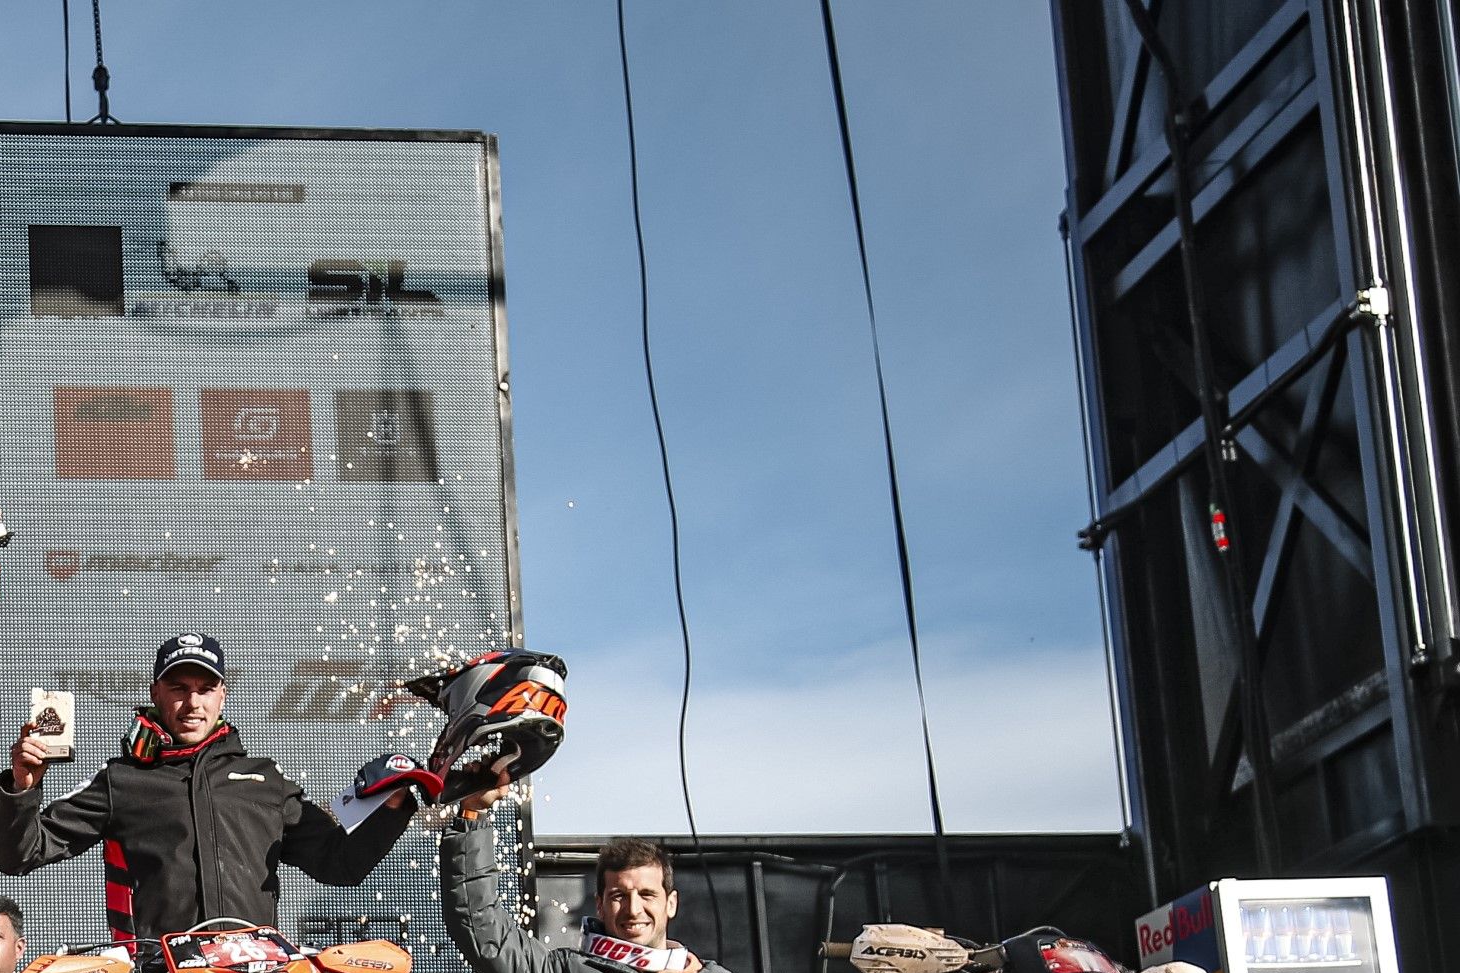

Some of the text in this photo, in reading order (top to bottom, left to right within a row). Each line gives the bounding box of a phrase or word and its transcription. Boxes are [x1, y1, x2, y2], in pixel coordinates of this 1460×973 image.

[1139, 895, 1214, 958] Red Bull
[221, 941, 268, 963] 26
[860, 946, 927, 961] ACERBIS
